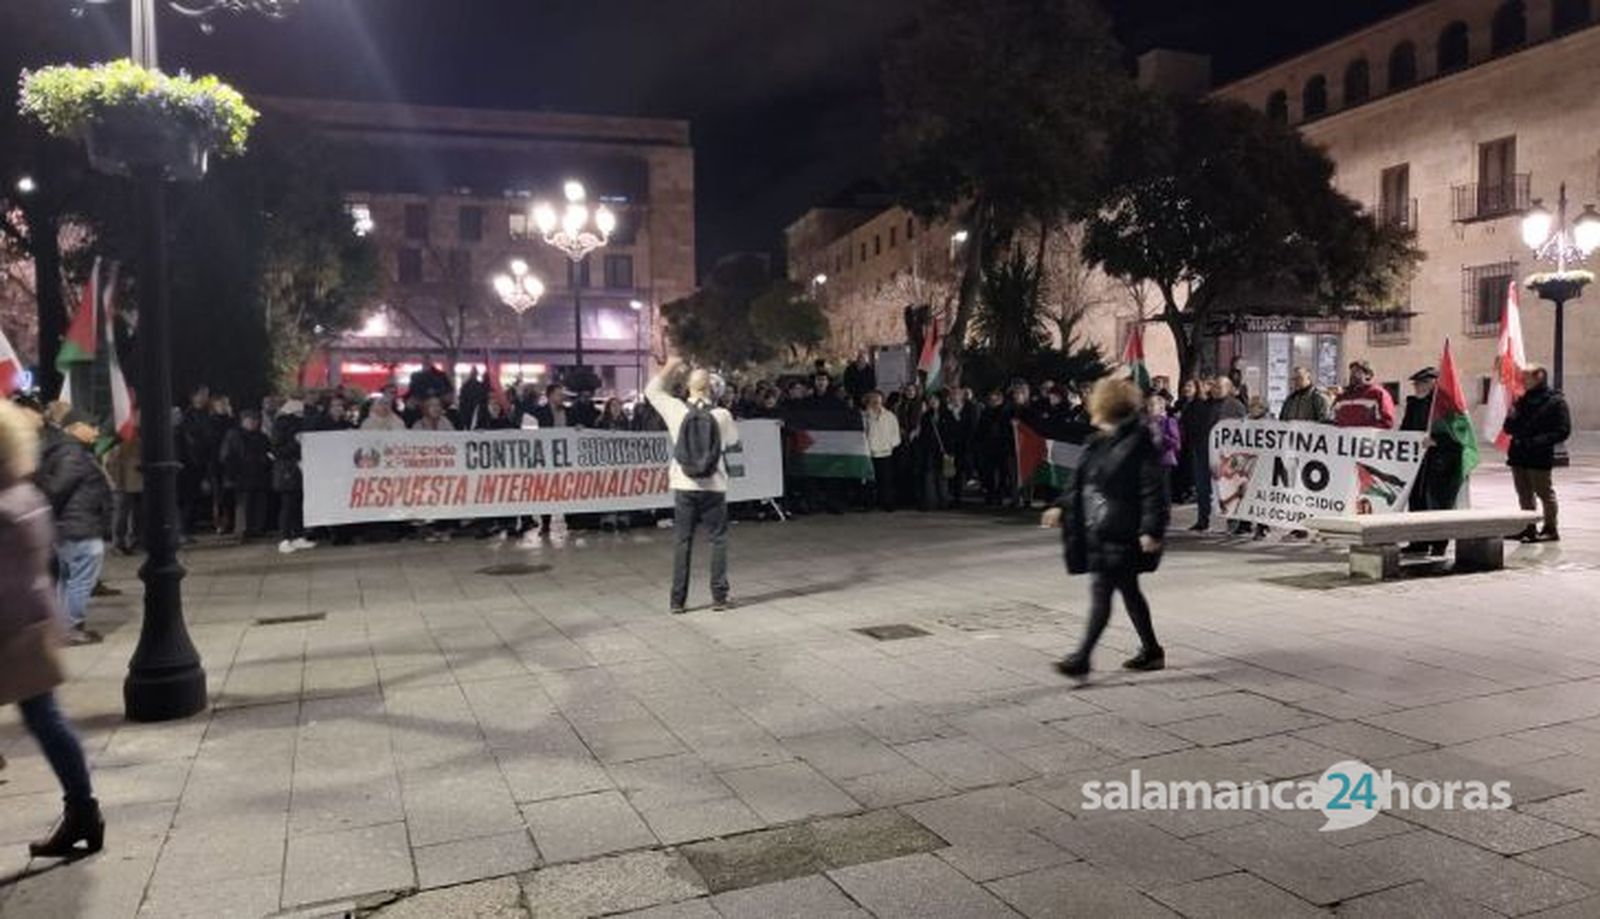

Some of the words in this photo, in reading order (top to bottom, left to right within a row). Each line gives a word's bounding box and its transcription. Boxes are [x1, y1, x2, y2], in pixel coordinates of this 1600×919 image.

[465, 439, 546, 469] CONTRA
[552, 438, 572, 468] EL
[1214, 427, 1329, 456] ¡PALESTINA
[1337, 436, 1420, 463] LIBRE!
[350, 474, 469, 508] RESPUESTA
[474, 464, 669, 504] INTERNACIONALISTA
[1272, 456, 1331, 492] NO
